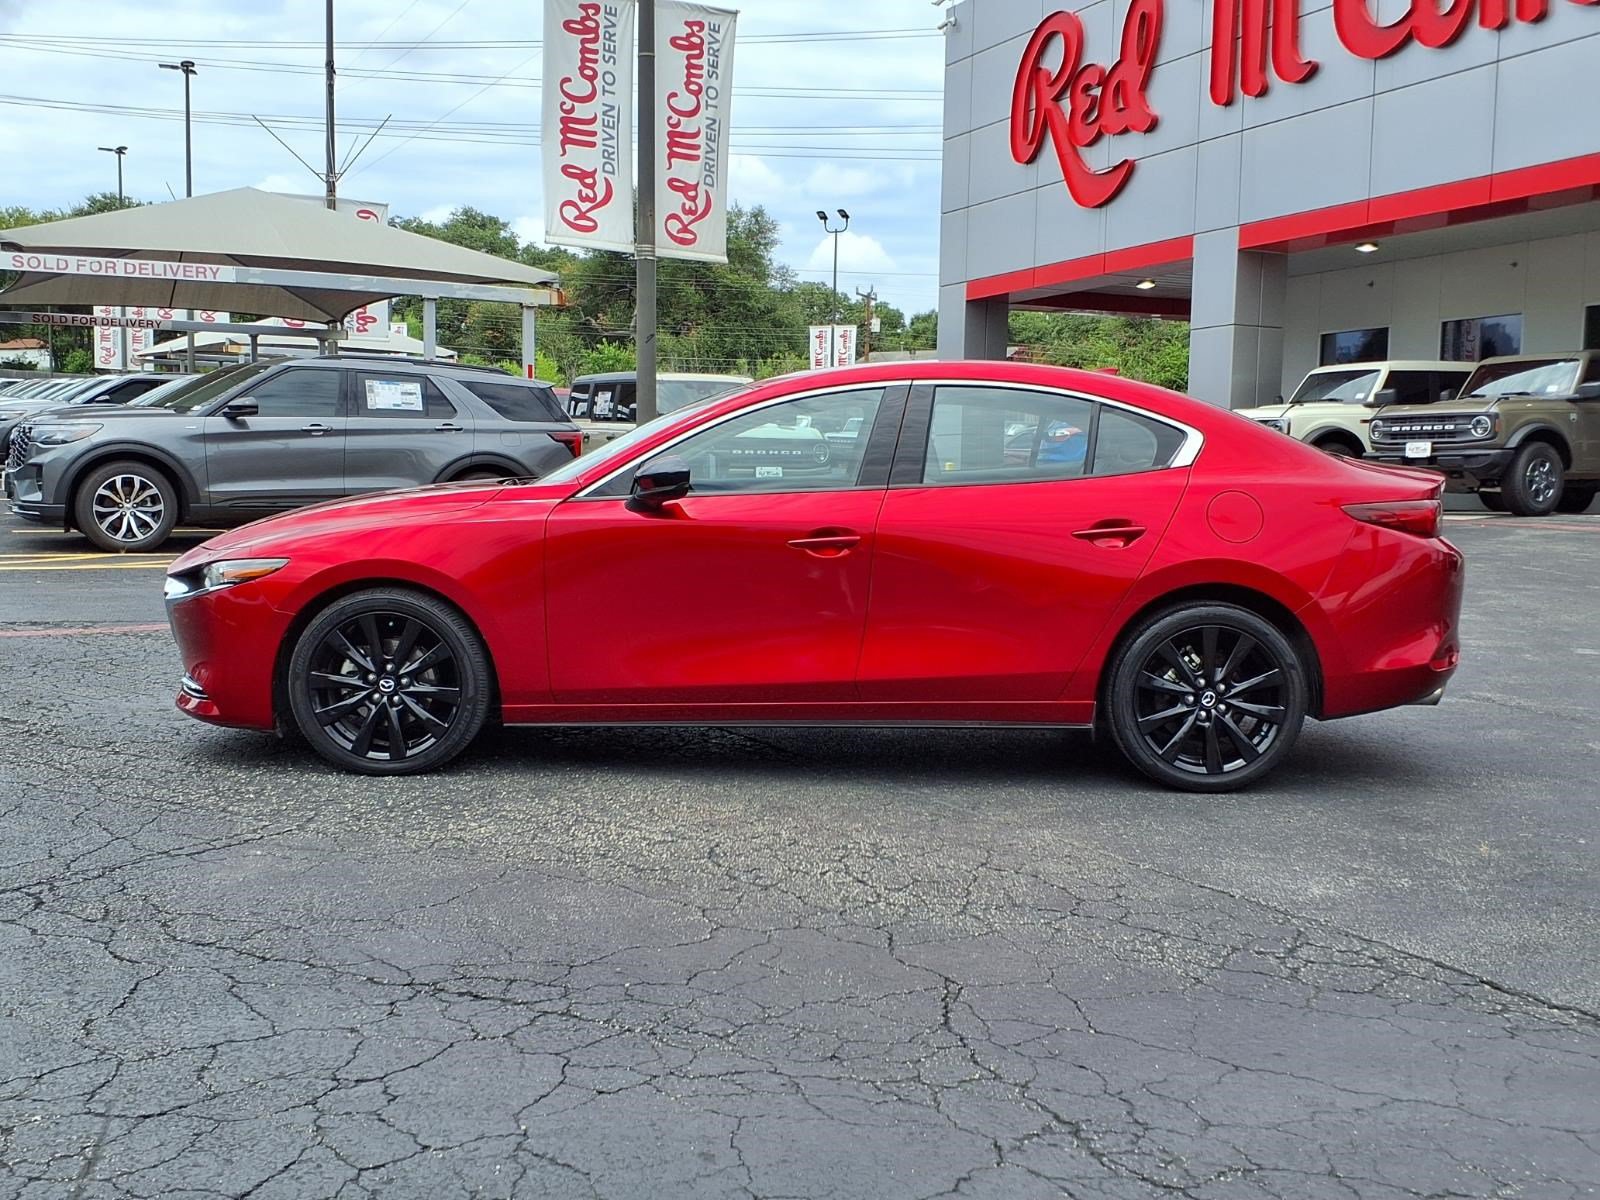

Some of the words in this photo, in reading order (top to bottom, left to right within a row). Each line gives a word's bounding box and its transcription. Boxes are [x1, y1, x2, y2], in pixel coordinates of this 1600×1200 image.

[603, 5, 617, 65] SERVE
[707, 22, 720, 80] SERVE
[560, 3, 601, 157] McCombs
[602, 71, 616, 96] TO
[667, 20, 705, 170] McCombs
[705, 86, 719, 110] TO
[1010, 0, 1164, 208] Red
[602, 102, 615, 176] DRIVEN
[704, 117, 717, 188] DRIVEN
[560, 164, 613, 233] Red
[665, 177, 712, 246] Red
[12, 255, 69, 271] SOLD
[76, 259, 117, 275] FOR
[124, 262, 220, 280] DELIVERY
[32, 313, 68, 325] SOLD
[72, 316, 97, 326] FOR
[101, 318, 162, 329] DELIVERY
[99, 346, 116, 365] Red
[1391, 424, 1455, 432] BRONCO
